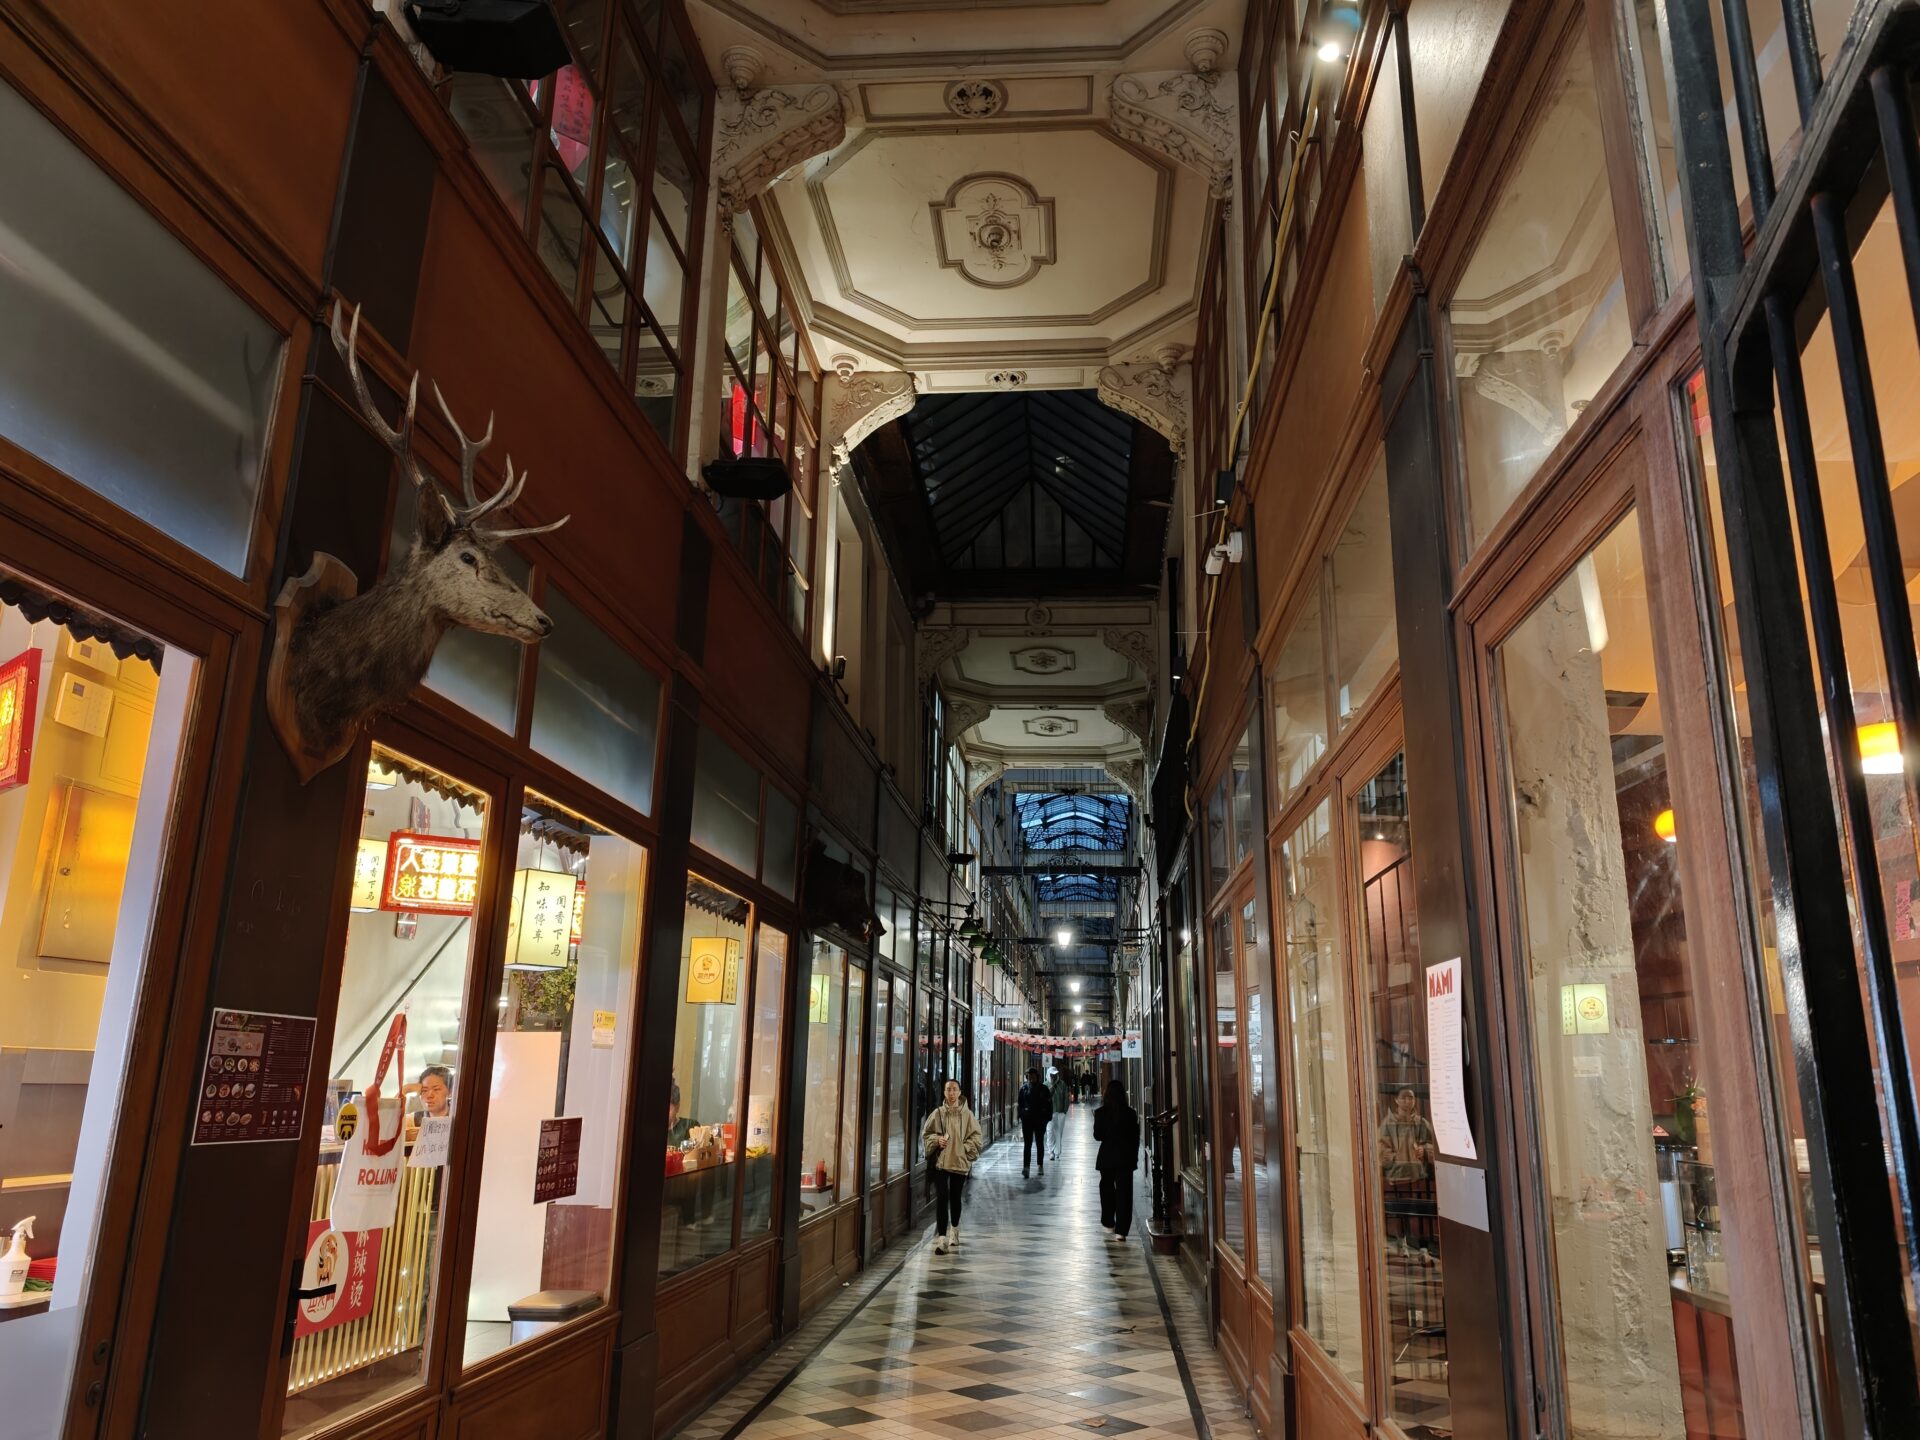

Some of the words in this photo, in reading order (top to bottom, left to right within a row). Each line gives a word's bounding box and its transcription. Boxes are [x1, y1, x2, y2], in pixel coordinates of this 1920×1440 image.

[532, 881, 551, 943] 知味停车
[550, 895, 567, 957] 闻香下马
[1429, 967, 1453, 998] NAMI
[357, 1168, 398, 1186] ROLLING
